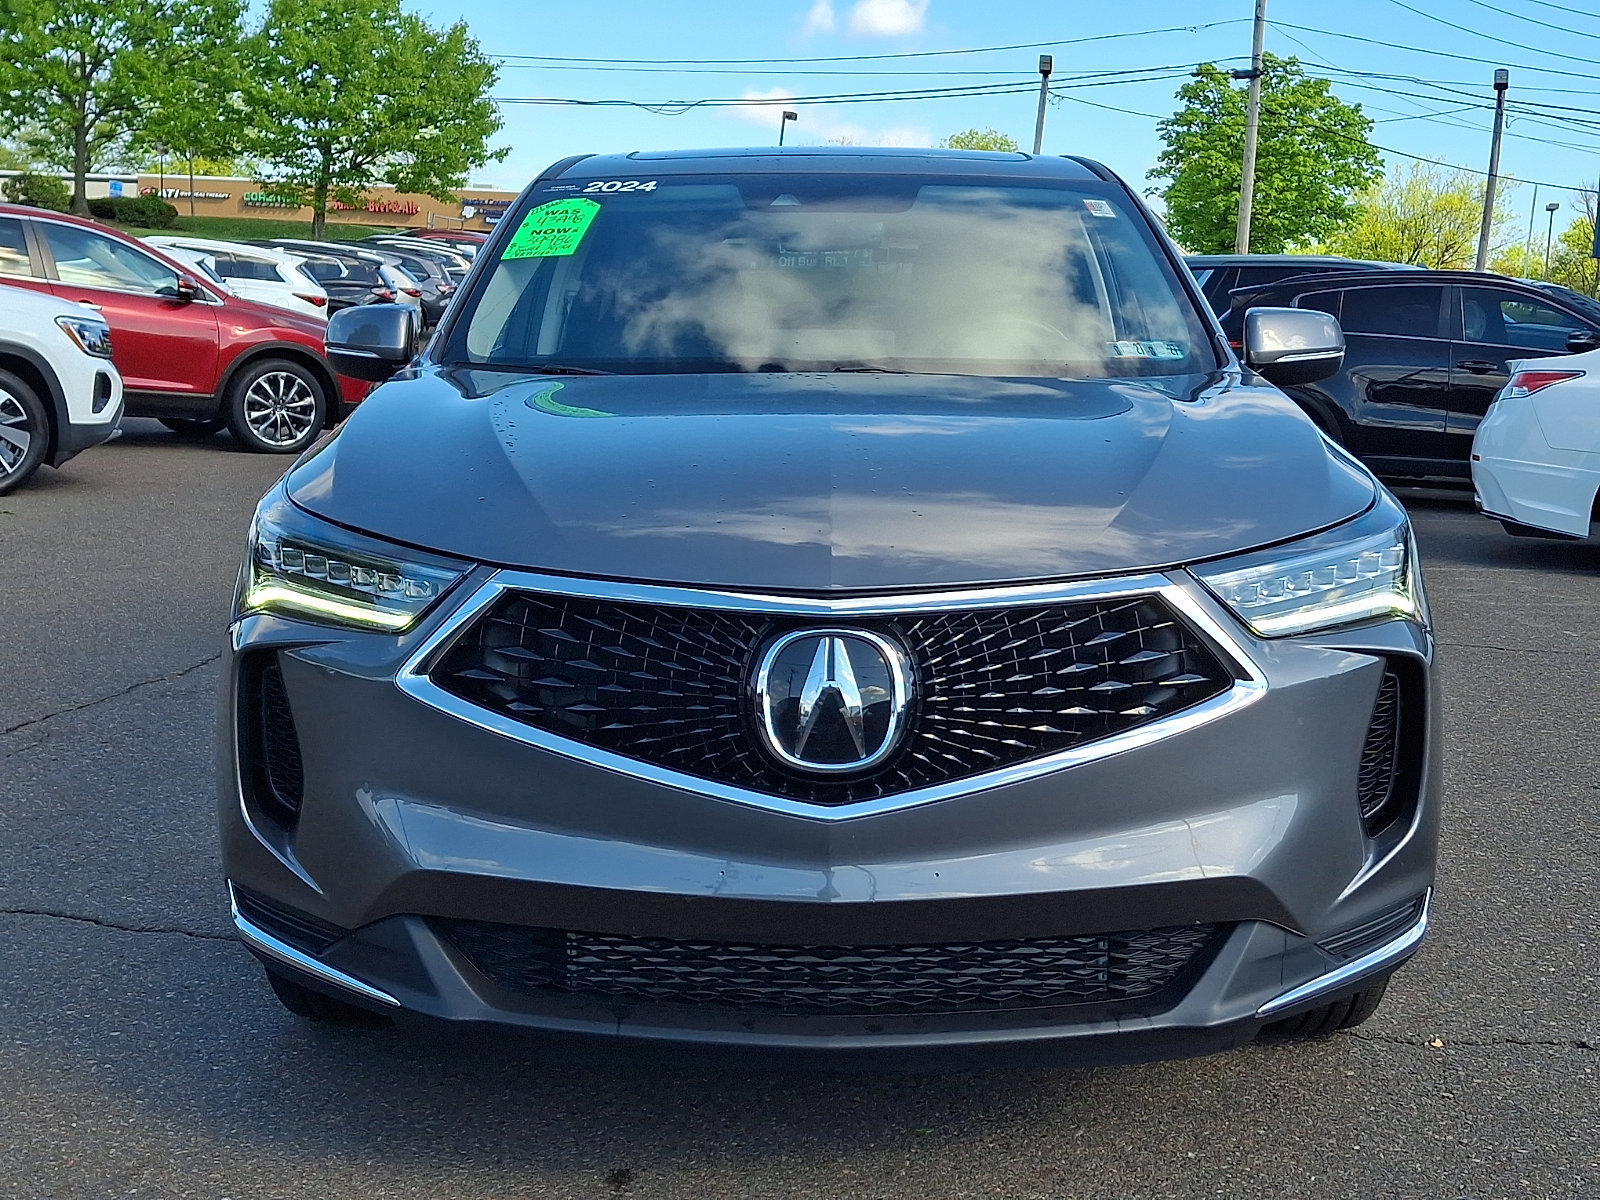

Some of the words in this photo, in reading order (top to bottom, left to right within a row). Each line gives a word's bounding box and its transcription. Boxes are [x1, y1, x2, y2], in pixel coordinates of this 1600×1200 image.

[582, 180, 657, 193] 2024
[545, 208, 581, 216] WAS
[530, 227, 572, 236] NOW
